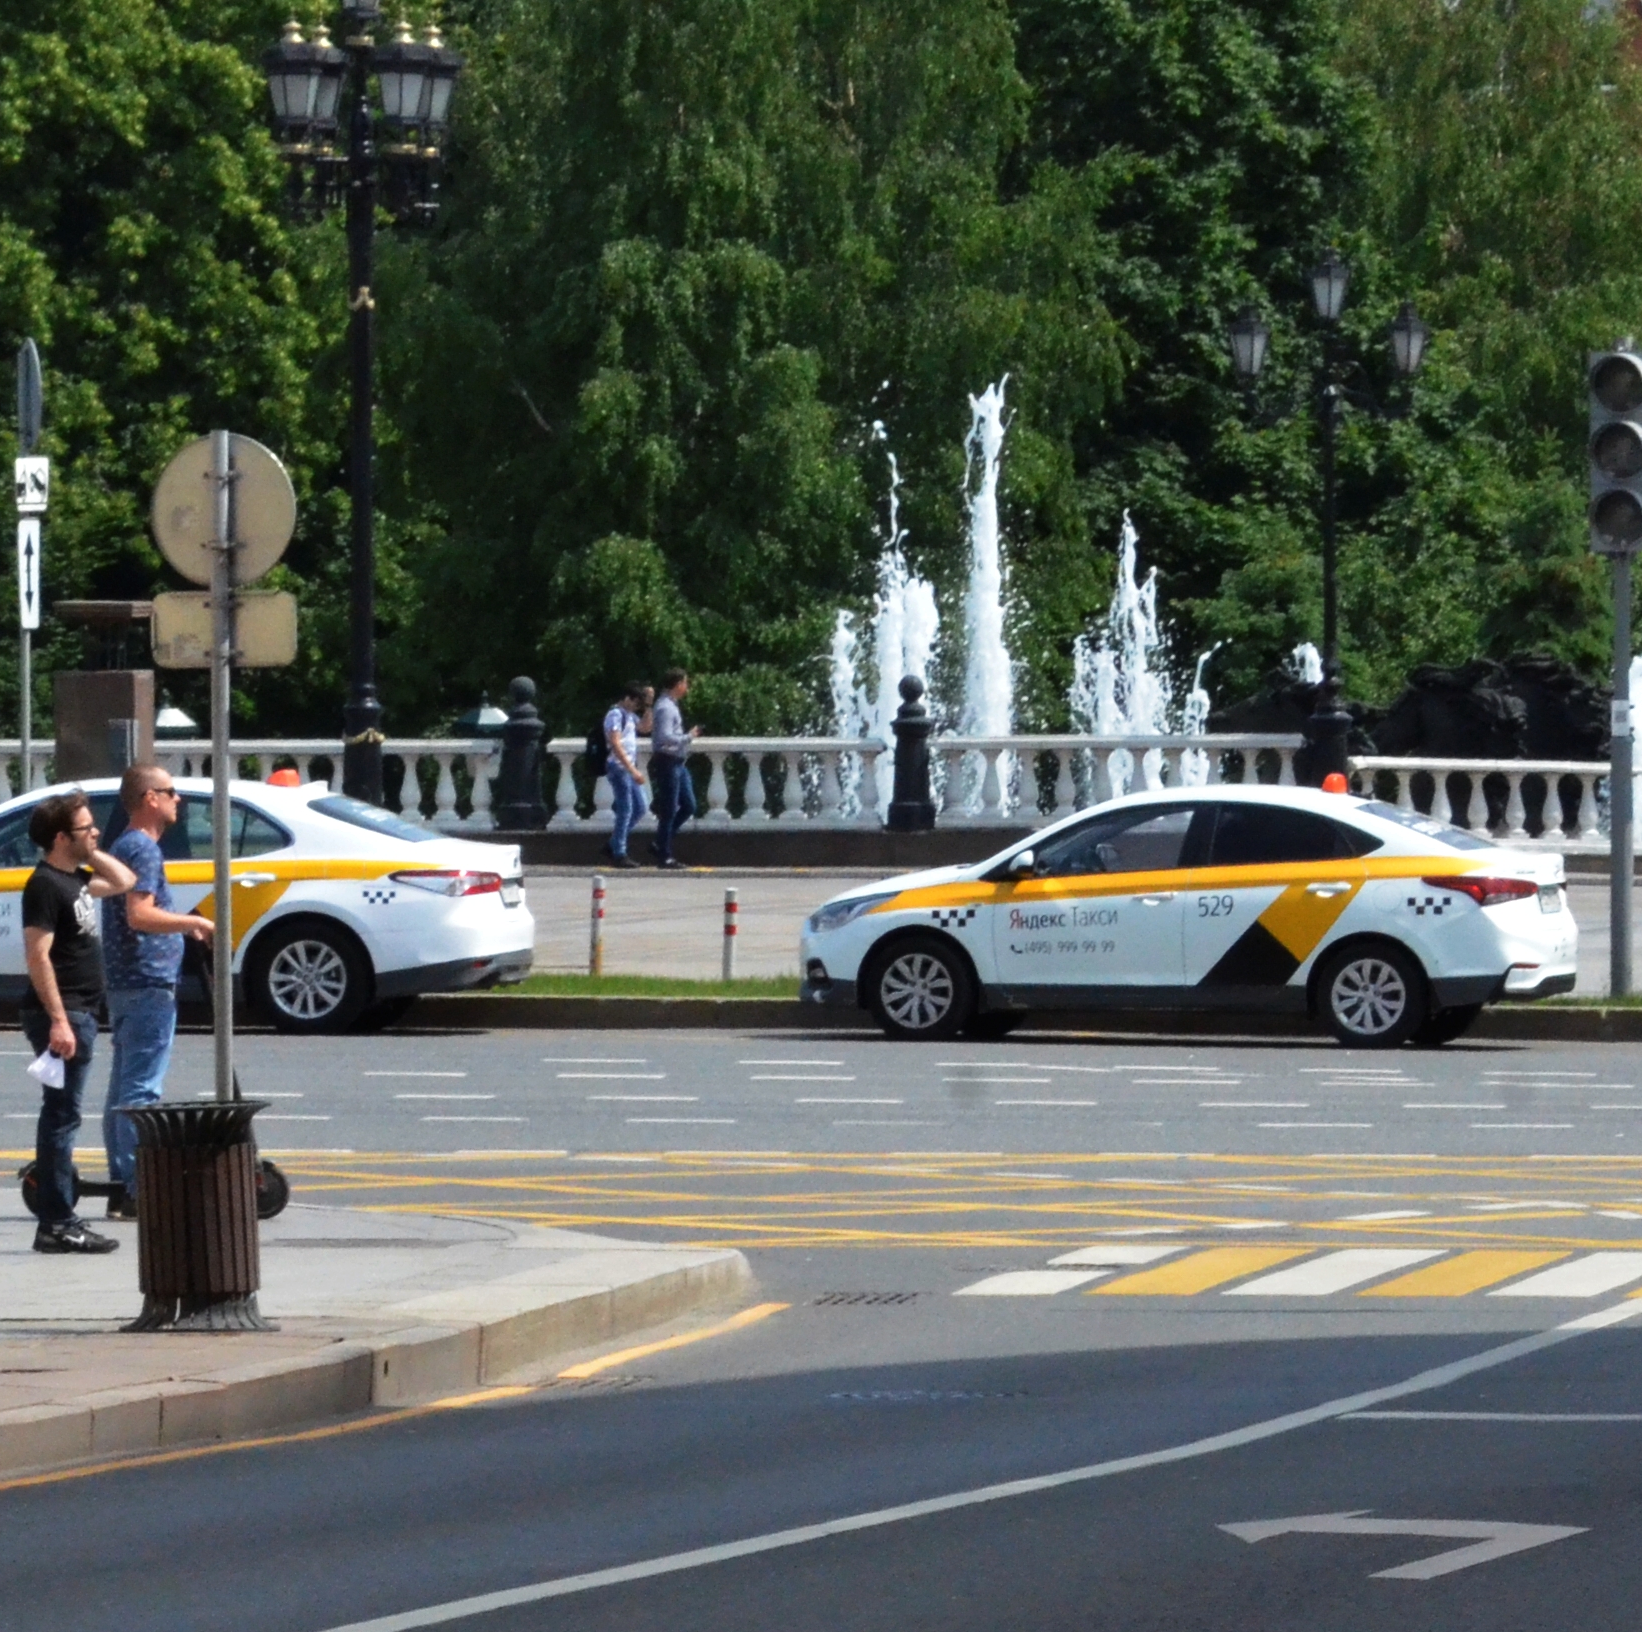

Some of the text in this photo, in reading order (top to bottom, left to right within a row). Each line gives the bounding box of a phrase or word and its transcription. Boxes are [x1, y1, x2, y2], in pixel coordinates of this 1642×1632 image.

[1198, 894, 1234, 917] 529
[1010, 906, 1118, 930] Яндекс Такси
[1057, 941, 1078, 953] 999
[1082, 940, 1096, 953] 99
[1101, 940, 1116, 953] 99
